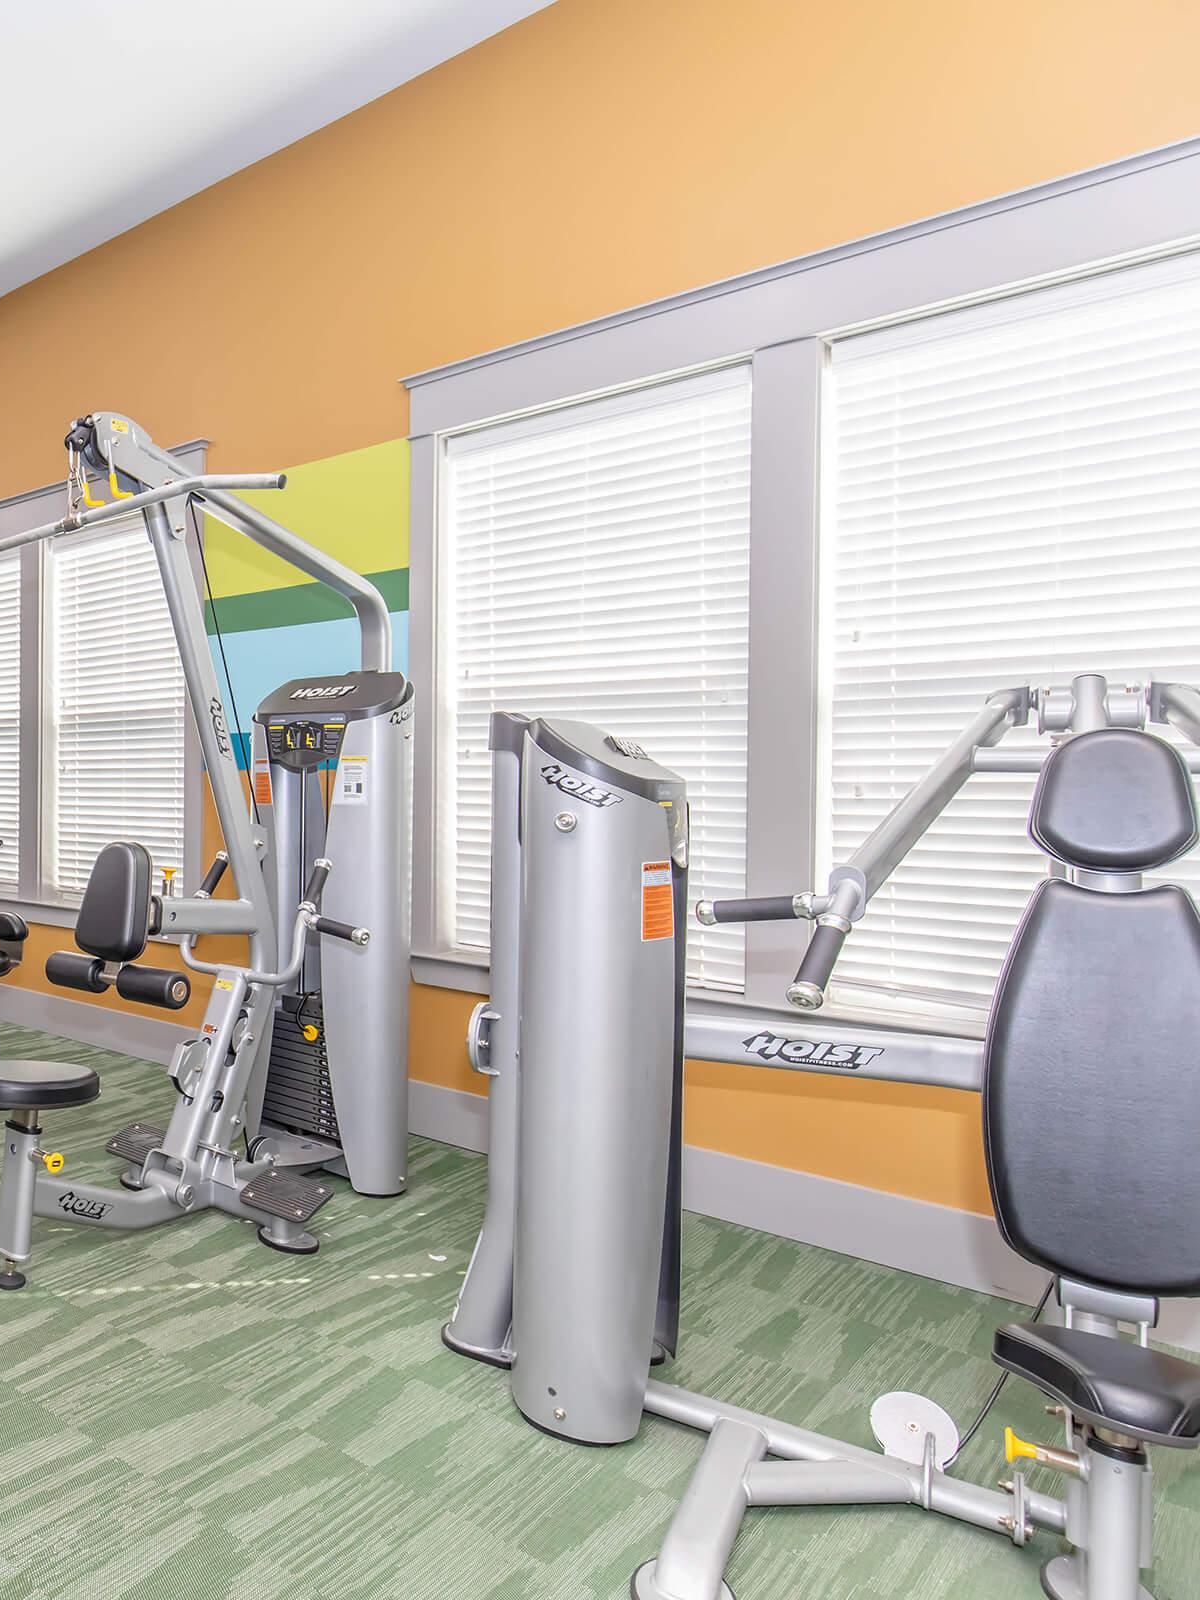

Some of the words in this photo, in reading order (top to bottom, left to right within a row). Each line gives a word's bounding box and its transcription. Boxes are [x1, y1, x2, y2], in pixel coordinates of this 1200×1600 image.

[290, 686, 357, 699] HOIST
[541, 765, 624, 807] HOIST
[745, 1035, 885, 1065] HOIST
[59, 1194, 114, 1217] HOIST
